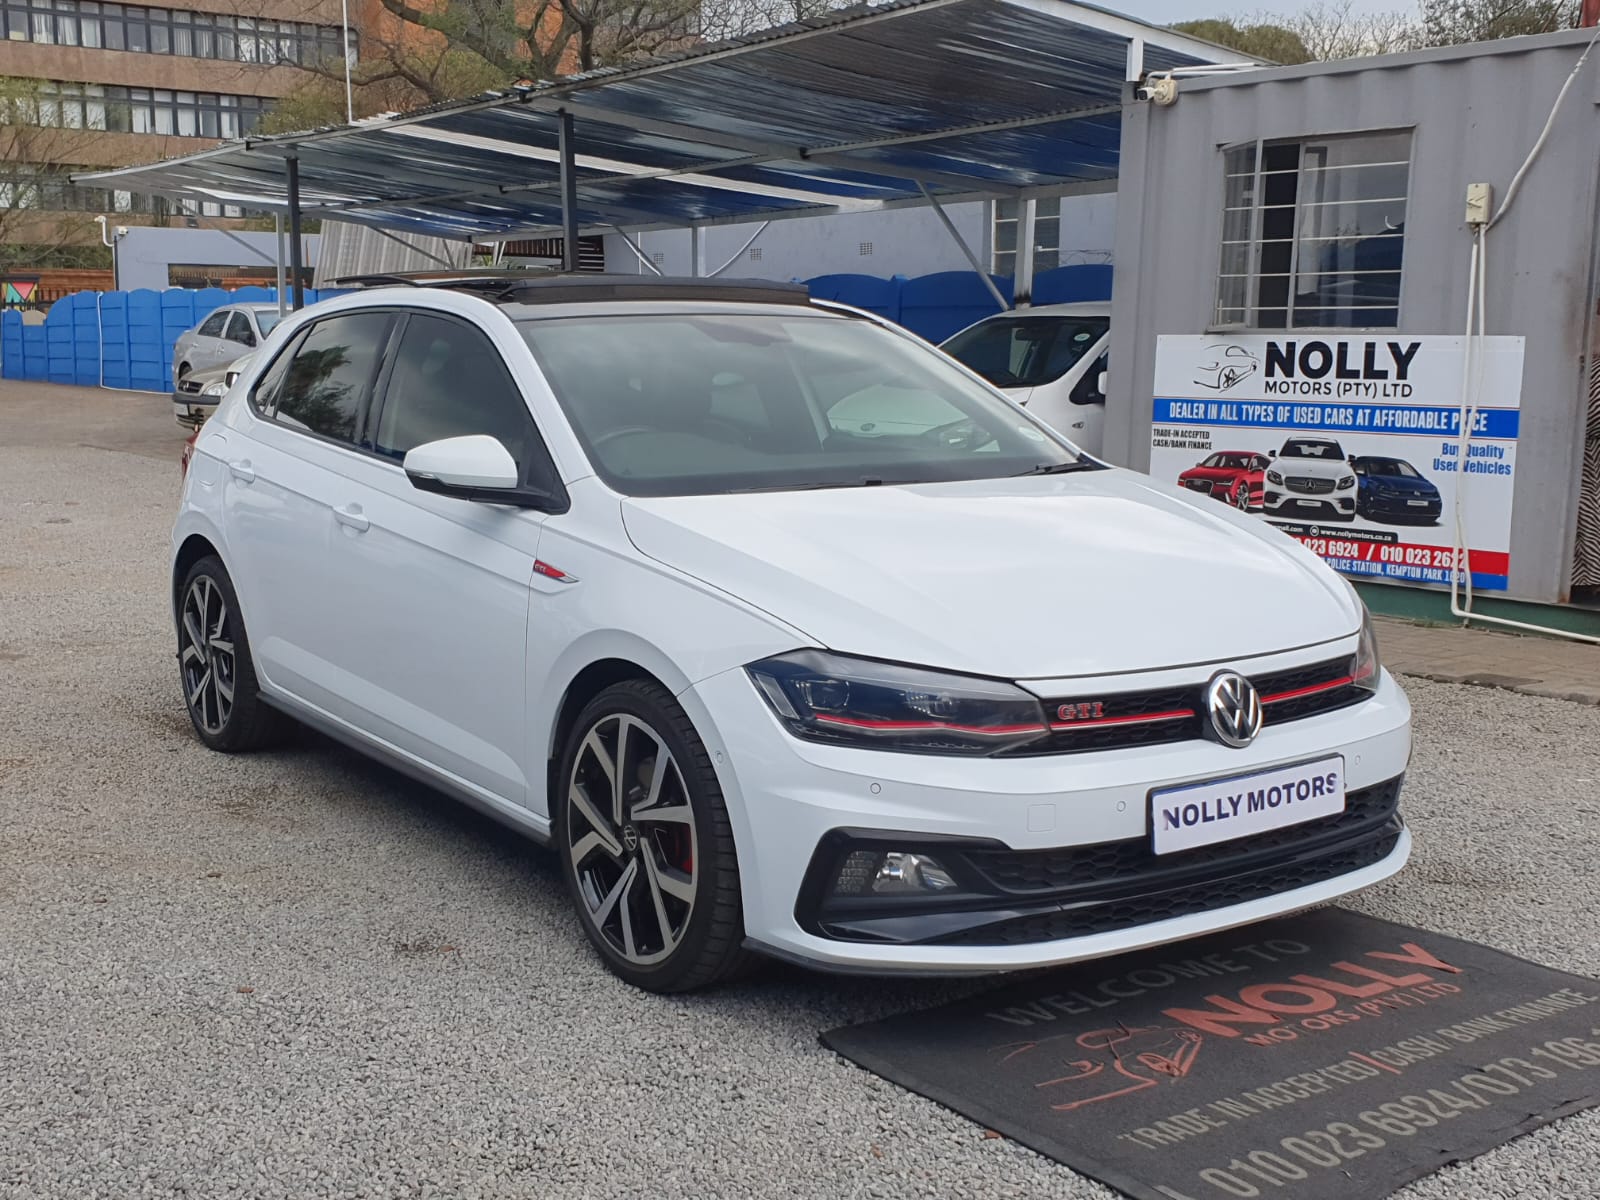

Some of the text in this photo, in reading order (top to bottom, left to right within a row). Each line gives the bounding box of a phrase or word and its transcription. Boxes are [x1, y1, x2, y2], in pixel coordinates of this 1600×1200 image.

[1264, 341, 1422, 380] NOLLY
[1264, 380, 1413, 399] MOTORS (PTY) LTD
[1169, 402, 1205, 419] DEALER
[1207, 405, 1217, 420] IN
[1220, 405, 1239, 421] ALL
[1241, 405, 1274, 422] TYPES
[1276, 406, 1291, 423] OF
[1293, 407, 1321, 424] USED
[1324, 408, 1353, 425] CARS
[1355, 409, 1371, 426] AT
[1373, 409, 1449, 430] AFFORDABLE
[1153, 428, 1210, 440] TRADE-IN ACCEPTED
[1187, 440, 1212, 450] FINANCE
[1328, 539, 1359, 558] 6924
[1380, 545, 1404, 563] 010
[1405, 547, 1431, 565] 023
[1326, 558, 1351, 571] POLICE
[1386, 564, 1421, 578] KEMPTON
[1422, 567, 1443, 581] PARK
[1057, 701, 1105, 720] GTI
[1163, 773, 1337, 831] NOLLY MOTORS
[985, 939, 1311, 1026] WELCOME TO
[1161, 941, 1464, 1038] NOLLY
[1243, 1009, 1361, 1047] MOTORS
[1414, 982, 1462, 998] LTD
[1117, 1108, 1228, 1149] TRADE
[1207, 1097, 1255, 1120] IN
[1496, 987, 1598, 1024] FINANCE
[1199, 1150, 1309, 1197] 010
[1280, 1121, 1387, 1168] 023
